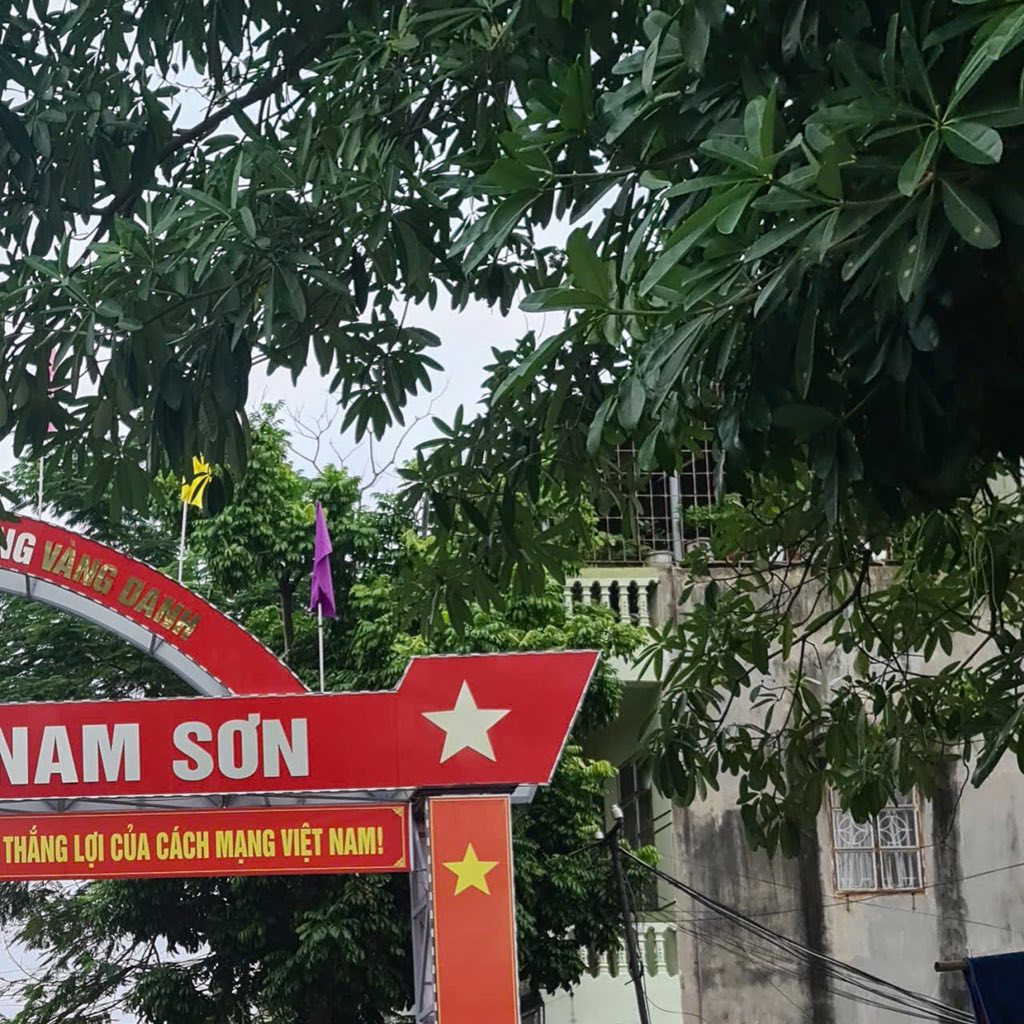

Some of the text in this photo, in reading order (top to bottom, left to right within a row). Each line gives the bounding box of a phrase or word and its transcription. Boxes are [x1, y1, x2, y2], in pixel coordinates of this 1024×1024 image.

[41, 539, 118, 595] VÀNG
[118, 576, 201, 641] DANH
[172, 713, 309, 782] SƠN
[3, 825, 68, 863] THẮNG
[74, 830, 104, 868] LỢI
[110, 824, 151, 861] CỦA
[156, 826, 209, 860] CÁCH
[215, 829, 275, 864] MẠNG
[280, 822, 323, 863] VIỆT
[329, 826, 384, 856] NAM!
